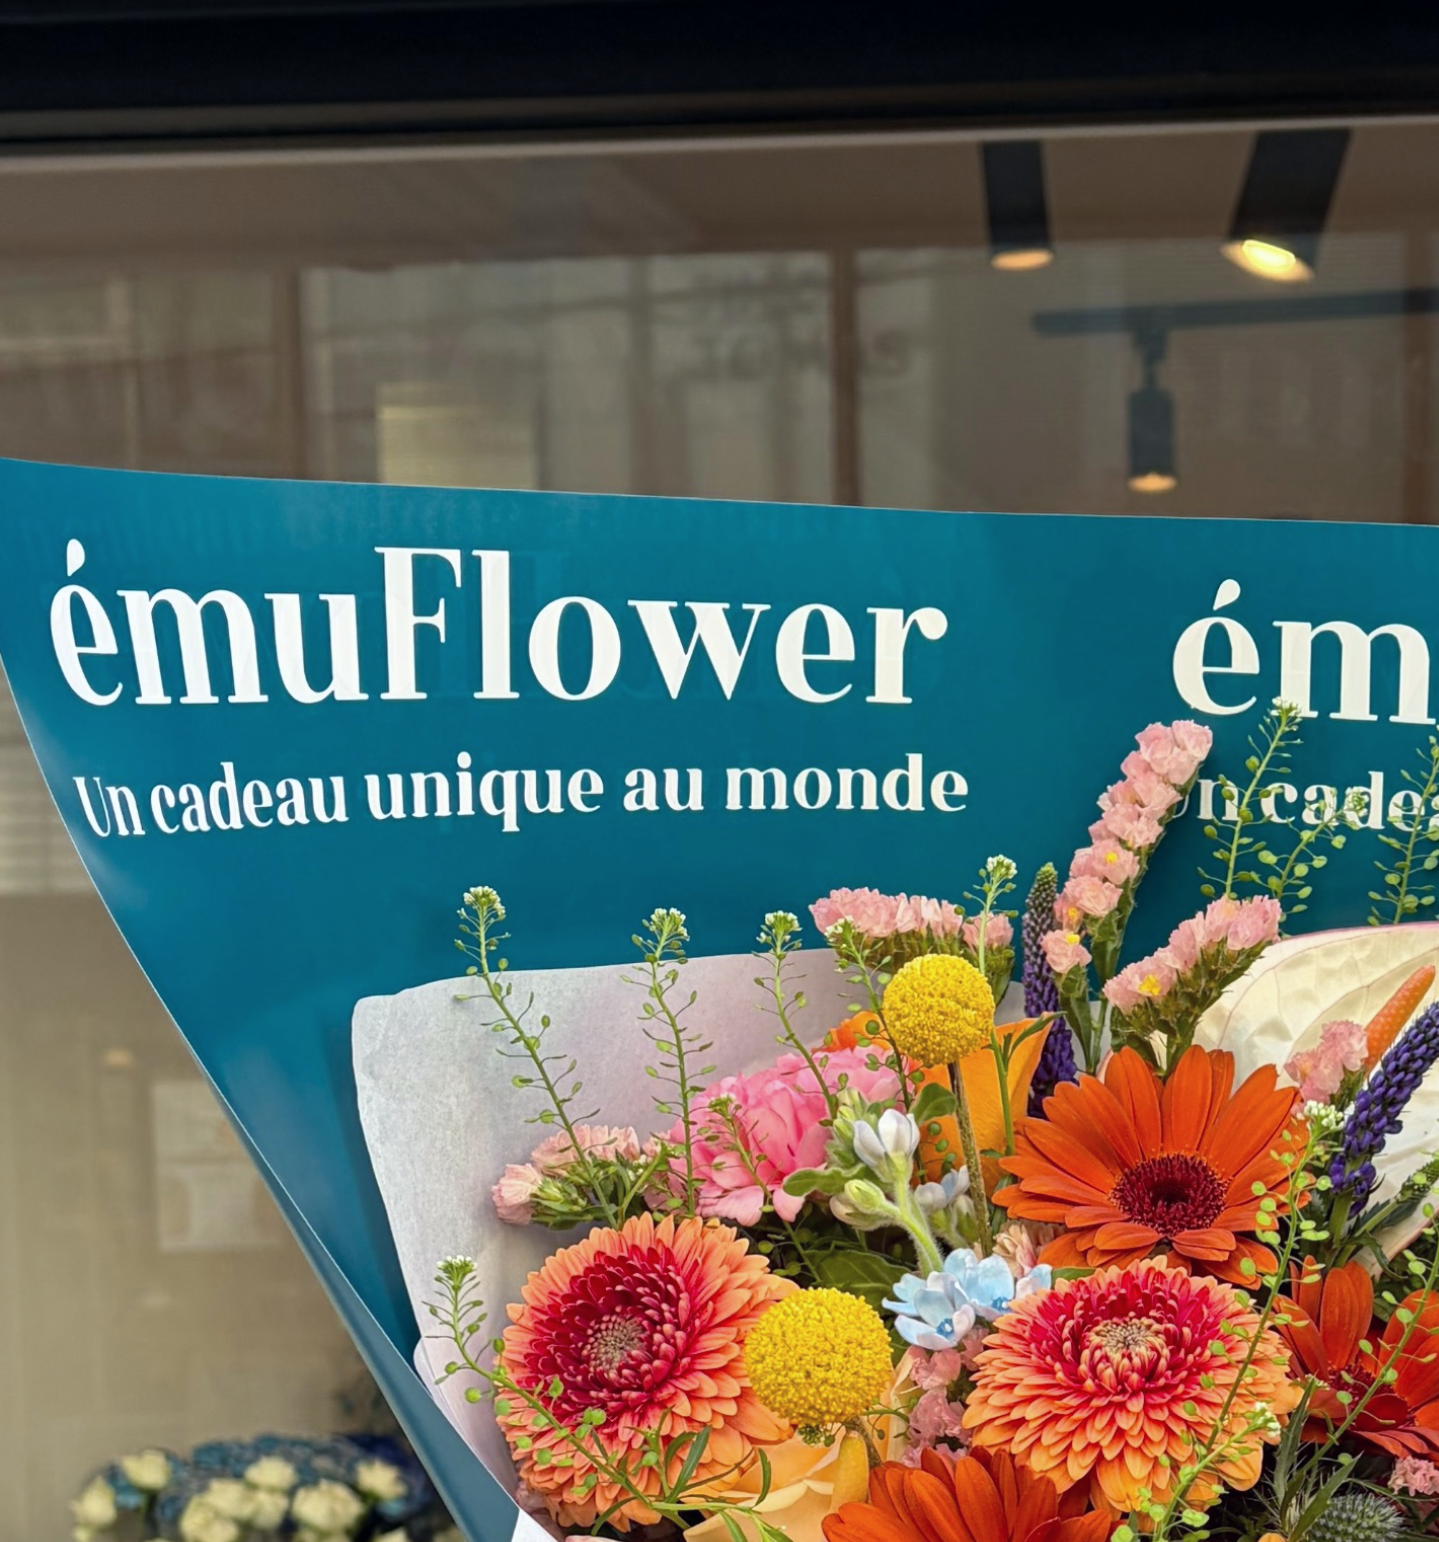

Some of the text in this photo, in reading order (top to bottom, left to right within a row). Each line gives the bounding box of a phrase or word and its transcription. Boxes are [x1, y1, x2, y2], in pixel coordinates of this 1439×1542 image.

[51, 539, 948, 706] émuFlower
[73, 751, 968, 838] Un cadeau unique au monde
